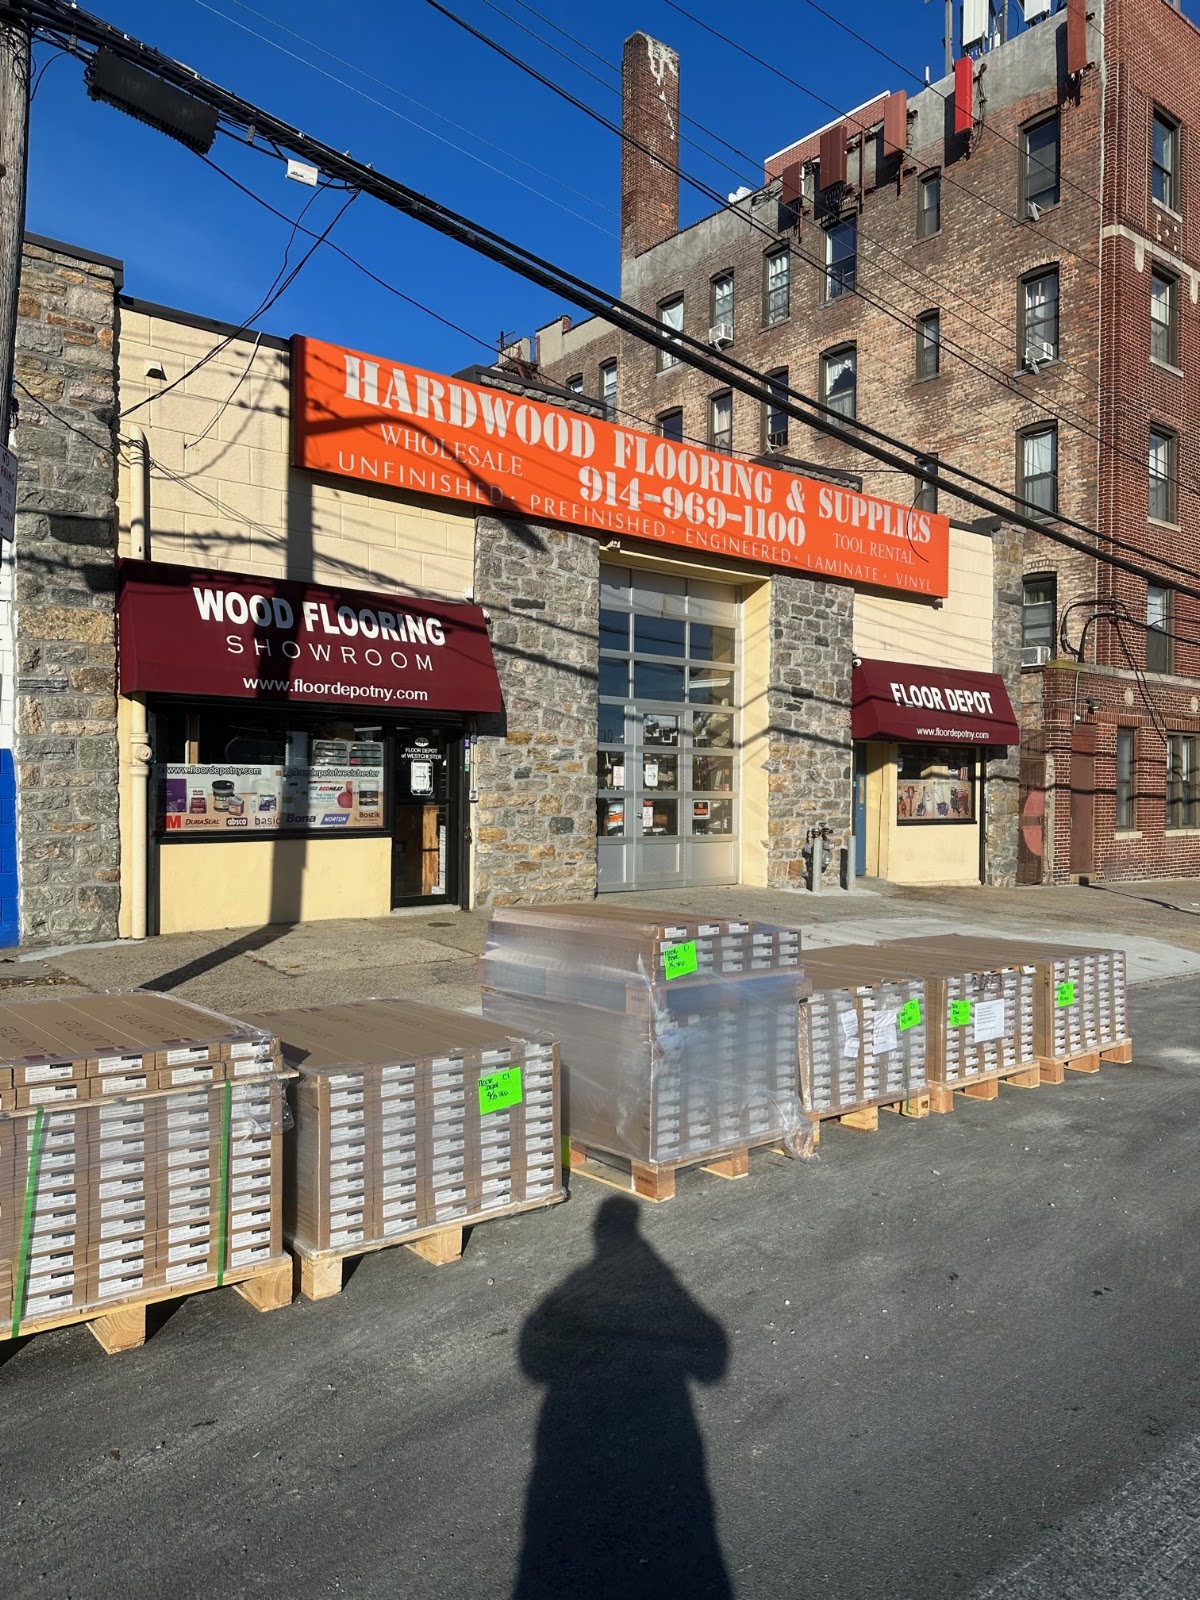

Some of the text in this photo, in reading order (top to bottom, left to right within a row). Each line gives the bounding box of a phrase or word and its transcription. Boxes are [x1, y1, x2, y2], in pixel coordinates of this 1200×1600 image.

[344, 354, 931, 544] HARDWOOD FLOORING & SUPPLIES
[380, 423, 523, 476] WHOLESALE
[337, 451, 932, 592] UNFINISHED PREFINISHED ENGINEERED LAMINATE VINYL
[578, 465, 806, 547] 914-969-1100
[833, 533, 915, 566] TOOL RENTAL
[193, 587, 446, 646] WOOD FLOORING
[226, 635, 434, 671] SHOWROOM
[243, 677, 428, 701] www.floordepotny.com
[890, 683, 993, 714] FLOOR DEPOT
[916, 727, 990, 741] www.floordepotny.com
[167, 765, 262, 776] www.floordepotny.com
[286, 814, 316, 823] Bona
